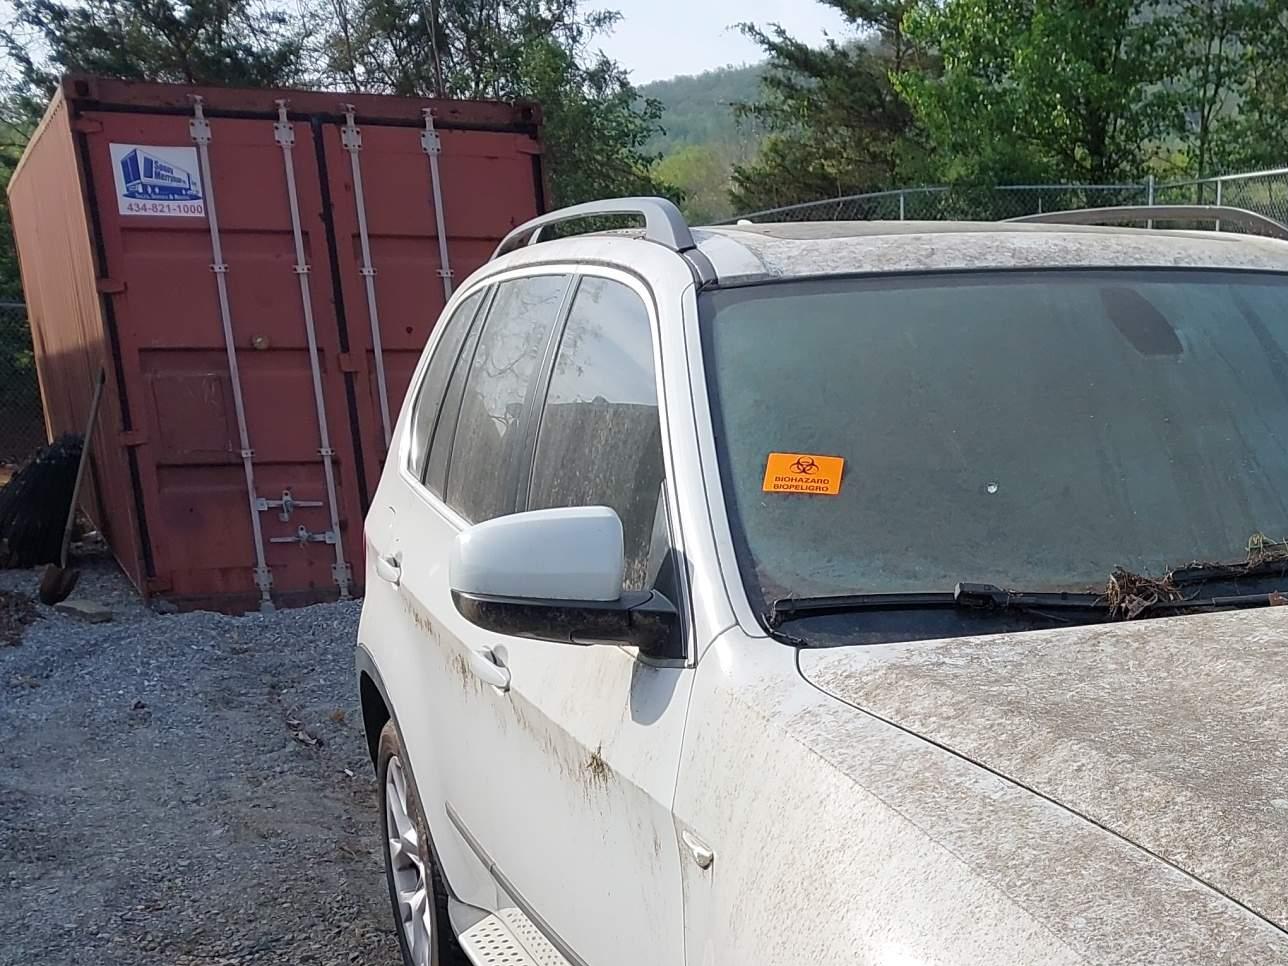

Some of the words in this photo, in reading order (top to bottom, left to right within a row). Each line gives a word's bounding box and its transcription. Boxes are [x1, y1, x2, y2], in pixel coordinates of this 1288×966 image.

[127, 202, 203, 214] 434-821-1000
[775, 476, 830, 485] BIOHAZARD
[773, 483, 829, 492] BIOPELIGRO
